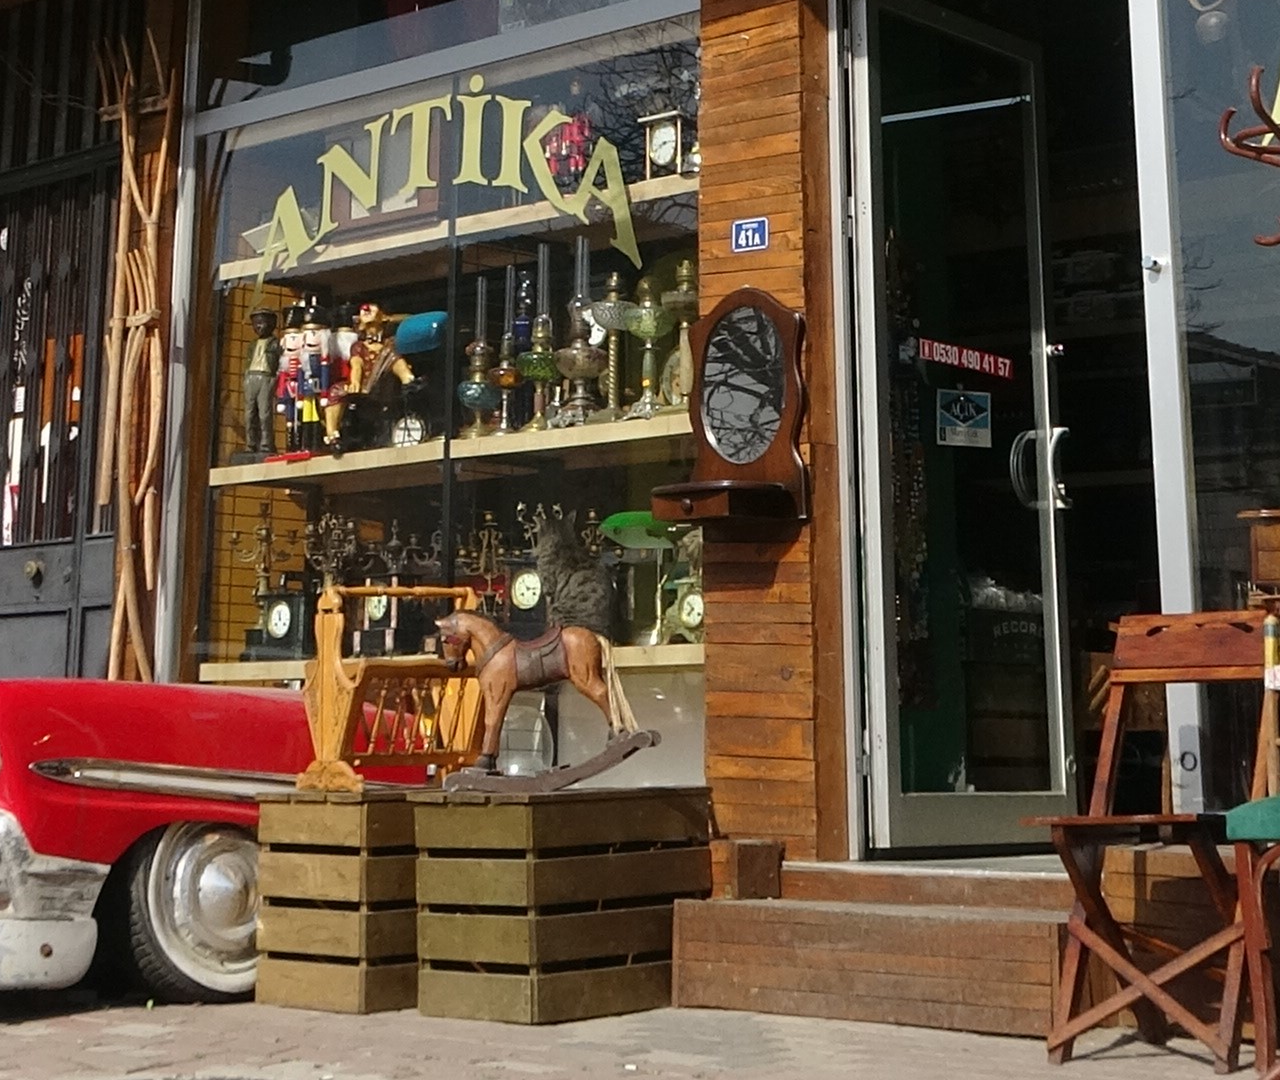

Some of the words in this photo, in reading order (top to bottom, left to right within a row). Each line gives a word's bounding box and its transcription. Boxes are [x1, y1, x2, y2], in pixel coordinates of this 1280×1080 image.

[251, 74, 642, 310] ANTİKA
[738, 228, 761, 247] 41A
[933, 341, 959, 366] 0530
[961, 348, 980, 370] 490
[982, 356, 995, 373] 41
[997, 358, 1011, 377] 57
[992, 620, 1041, 639] RECOR
